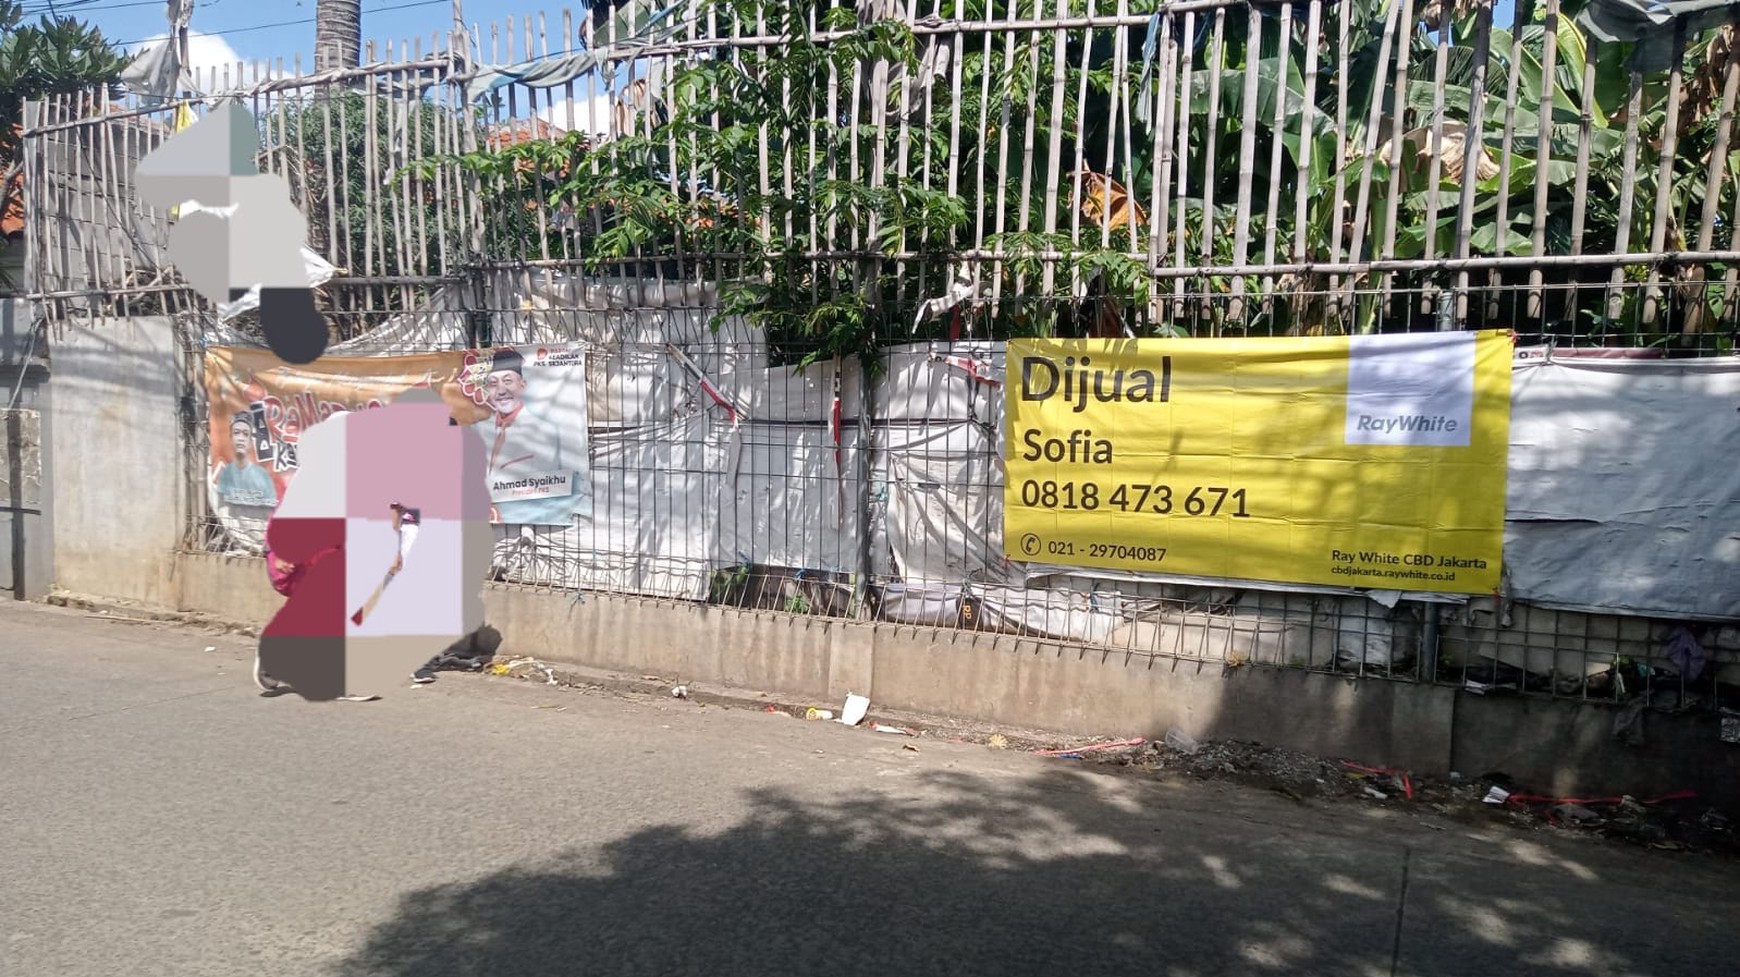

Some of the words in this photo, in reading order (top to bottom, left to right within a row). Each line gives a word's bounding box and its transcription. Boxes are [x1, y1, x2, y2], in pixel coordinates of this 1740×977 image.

[1022, 356, 1172, 412] Dijual
[1357, 415, 1458, 434] RayWhite
[1023, 429, 1113, 464] Sofia
[493, 478, 527, 490] Ahmad
[529, 475, 566, 488] Syaikhu
[1022, 480, 1099, 510] 0818
[1109, 484, 1172, 514] 473
[1184, 487, 1250, 517] 671
[1048, 541, 1075, 555] 021
[1089, 544, 1167, 561] 29704087
[1332, 550, 1356, 563] Ray
[1359, 552, 1400, 565] White
[1403, 554, 1434, 567] CBD
[1437, 556, 1487, 570] Jakarta
[1331, 566, 1456, 581] cbdjakarta.raywhite.co.id
